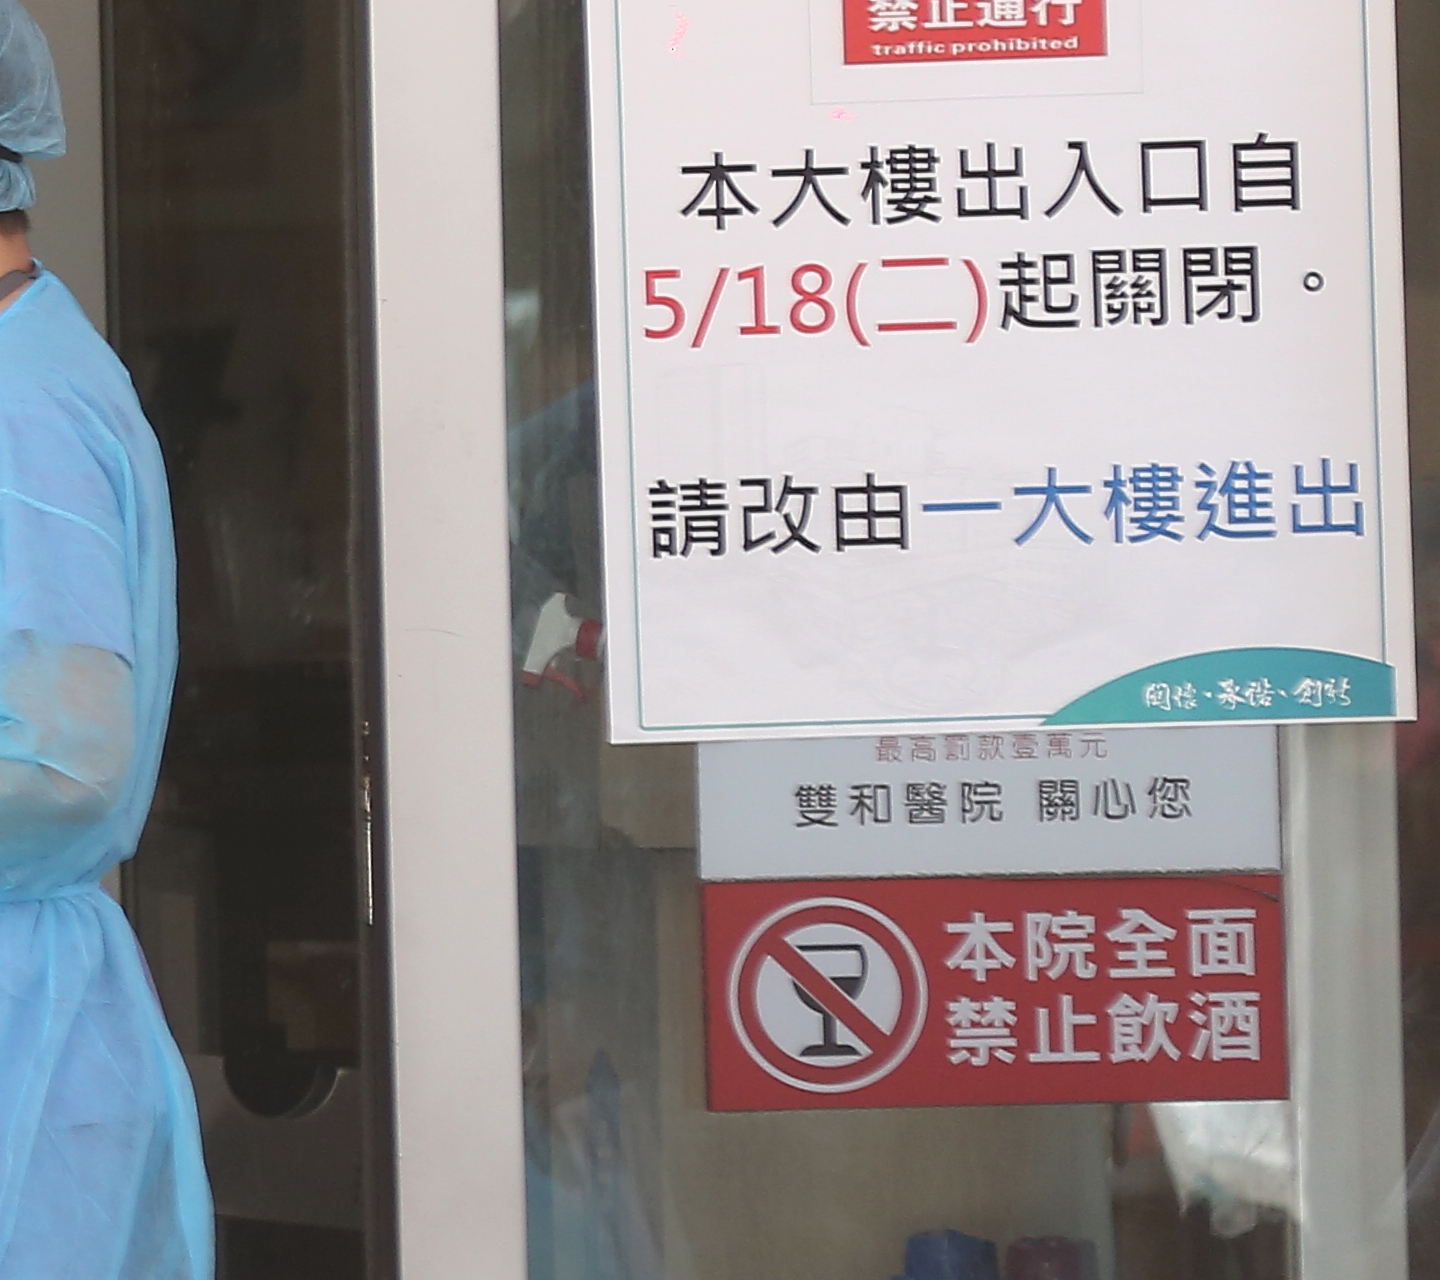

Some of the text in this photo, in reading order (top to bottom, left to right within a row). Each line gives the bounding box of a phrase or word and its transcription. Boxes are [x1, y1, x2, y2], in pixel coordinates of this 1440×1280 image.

[871, 34, 1080, 57] traffic prohibited
[679, 132, 1302, 231] 本大樓出入口自
[647, 457, 1366, 559] 請改由一大樓進出
[794, 775, 1193, 829] 雙和醫院 關心您
[944, 908, 1259, 983] 本院全面
[944, 991, 1263, 1067] 禁止飲酒
